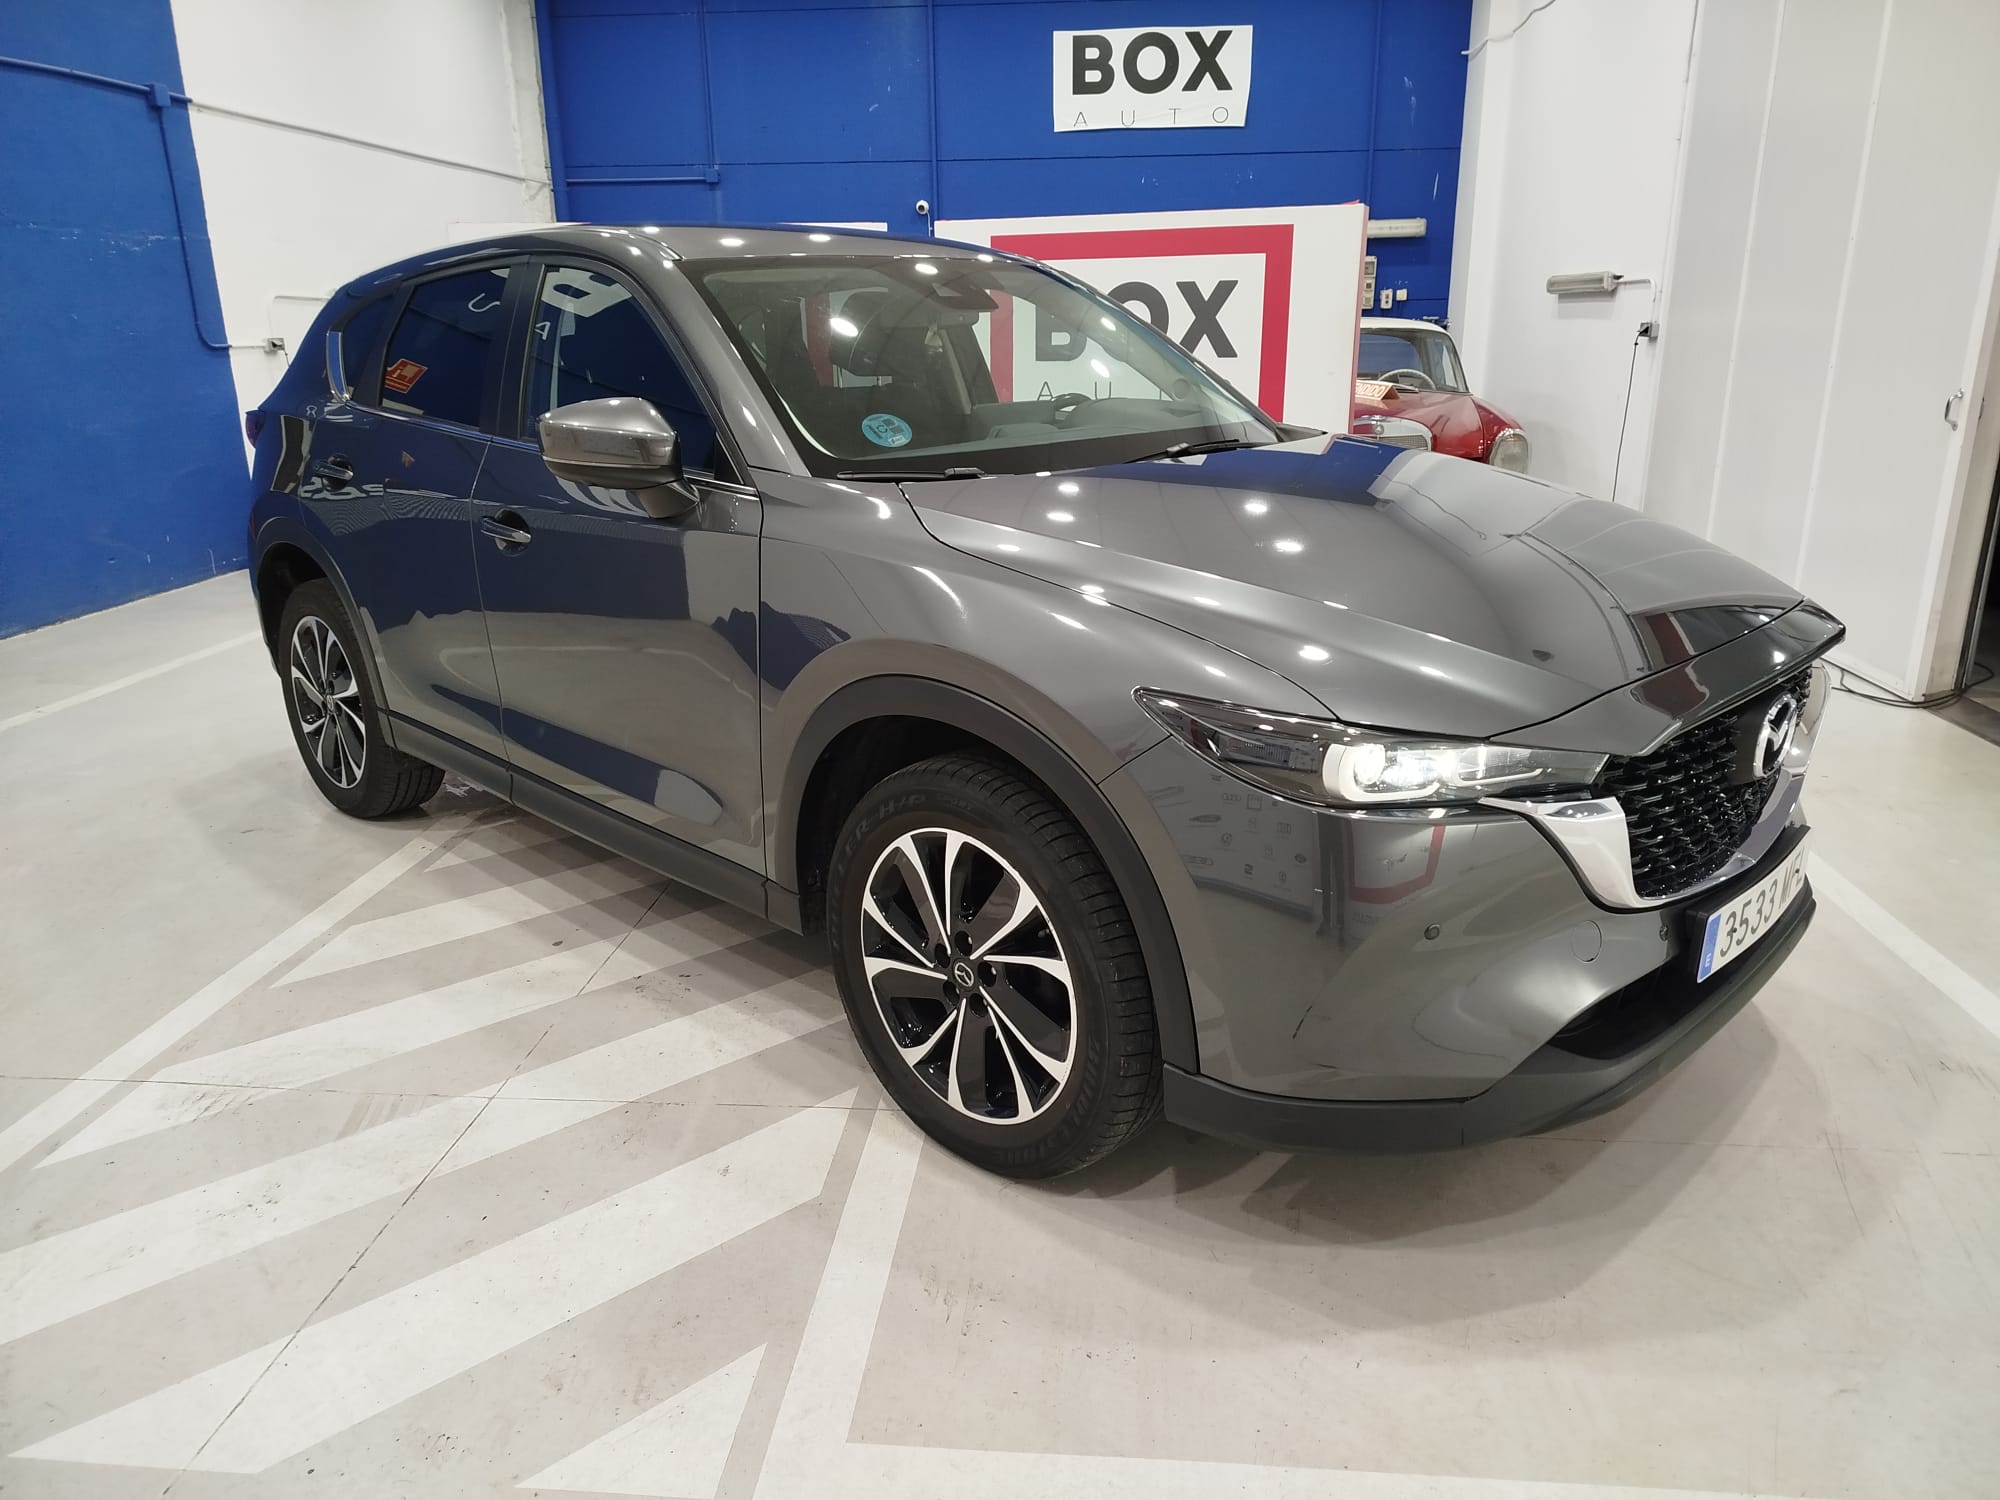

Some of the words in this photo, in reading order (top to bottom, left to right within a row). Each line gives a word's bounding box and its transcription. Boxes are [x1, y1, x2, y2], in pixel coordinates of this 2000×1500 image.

[1072, 30, 1233, 95] BOX
[1073, 106, 1229, 128] AUTO
[1719, 878, 1778, 957] 3533
